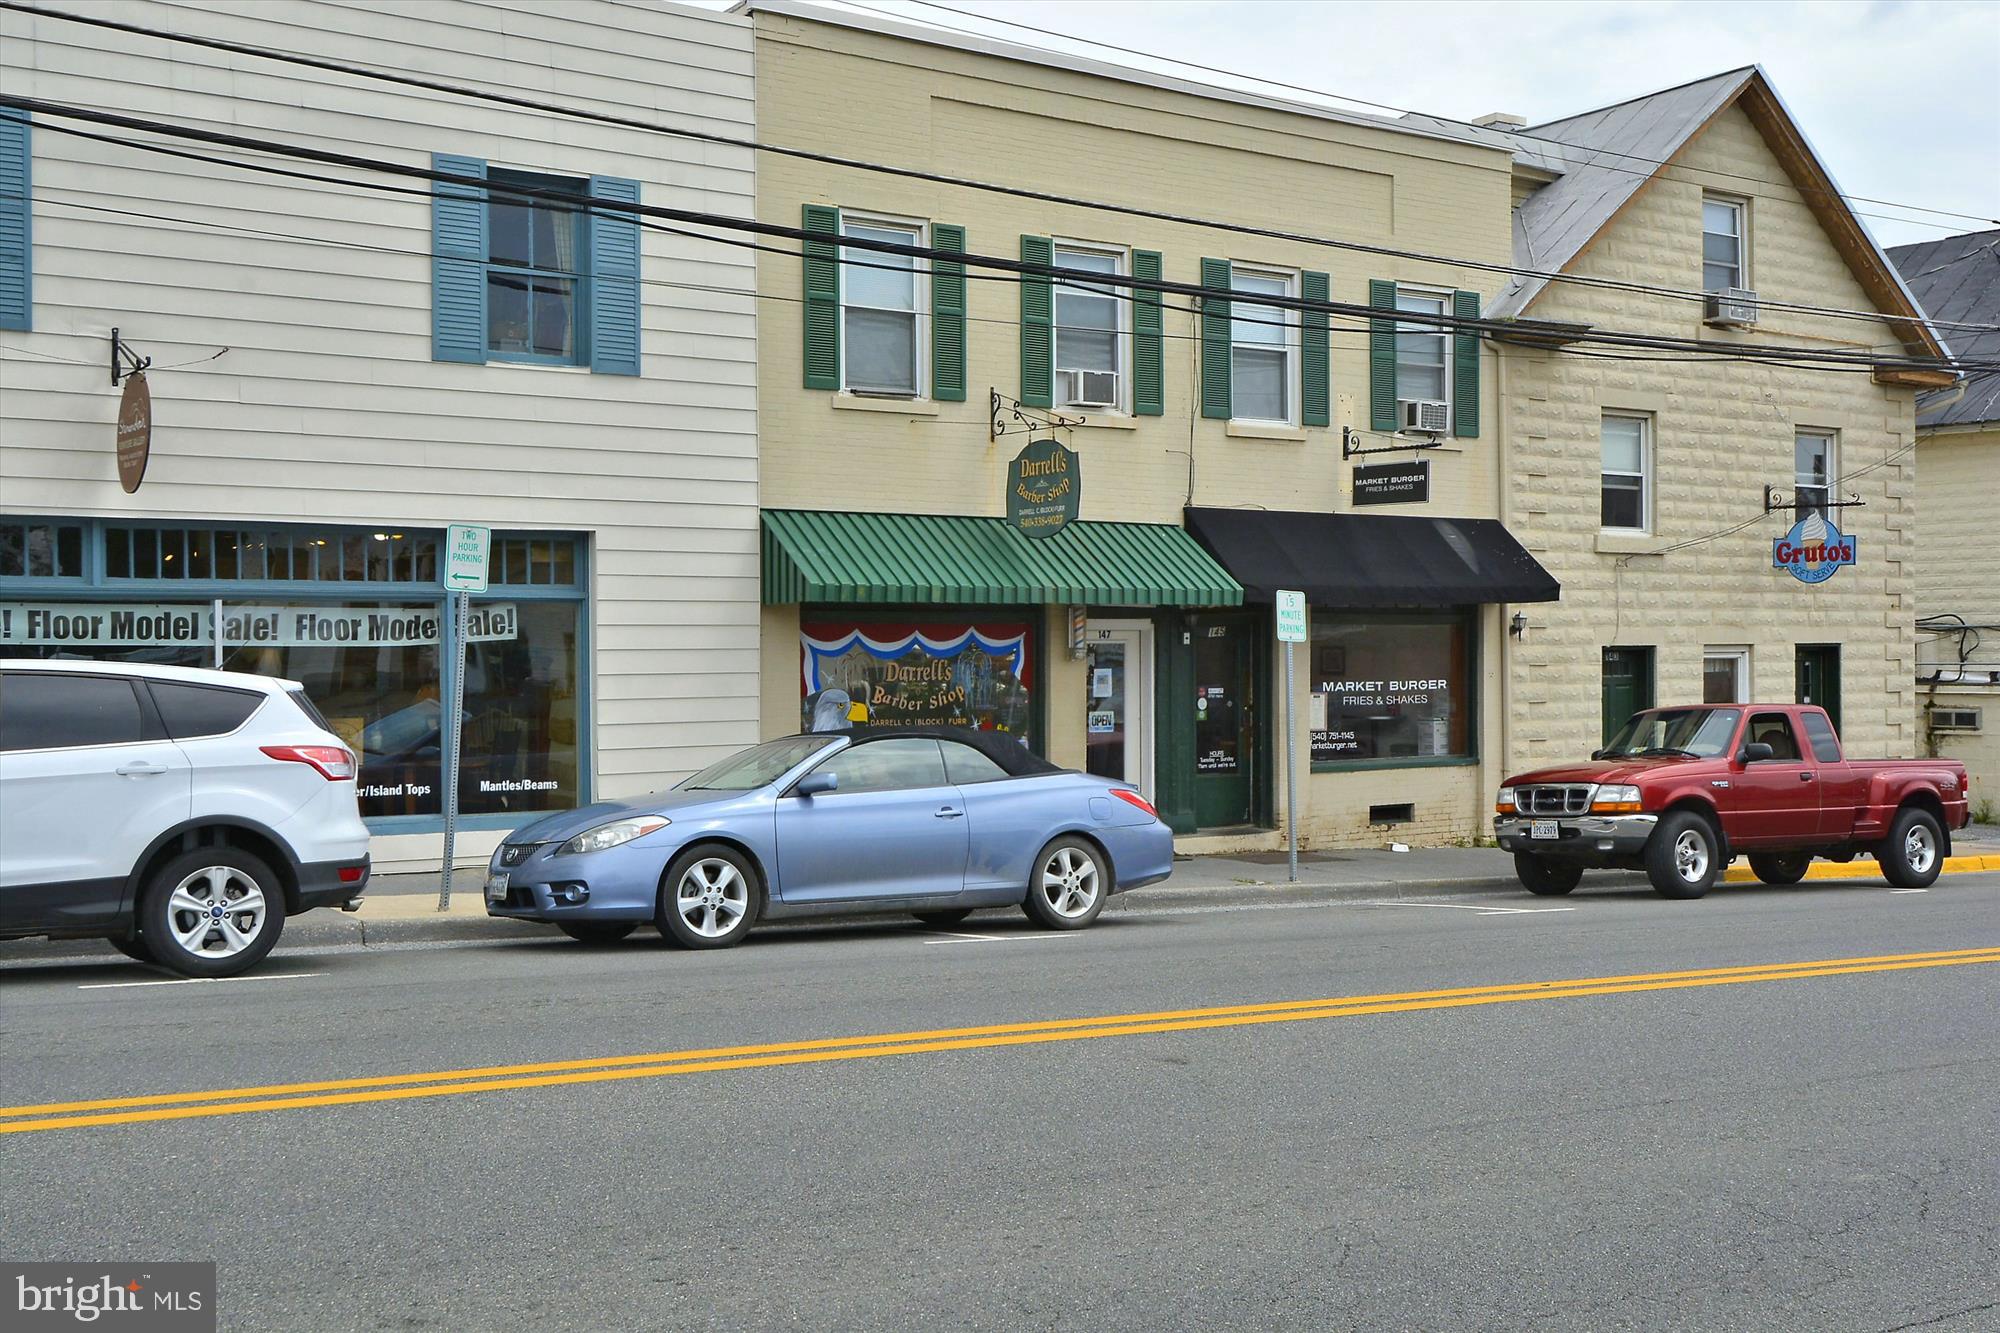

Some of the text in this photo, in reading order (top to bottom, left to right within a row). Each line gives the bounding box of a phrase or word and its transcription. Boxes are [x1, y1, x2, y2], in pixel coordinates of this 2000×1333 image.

[1021, 451, 1067, 477] Darrell's
[1355, 474, 1425, 486] MARKET BURGER
[1016, 478, 1070, 503] Barber Shop
[462, 531, 476, 541] TWO
[458, 542, 478, 552] HOUR
[1776, 540, 1852, 563] Gruto's
[453, 552, 482, 564] PARKING
[1791, 562, 1835, 579] SOFT SERVE
[1287, 597, 1295, 607] 15
[1281, 610, 1302, 620] MINUTE
[27, 610, 103, 640] Floor
[111, 611, 199, 640] Model
[295, 613, 362, 641] Floor
[455, 608, 514, 637] ale!
[1280, 623, 1304, 633] PARKING
[1098, 630, 1111, 639] 147
[885, 659, 953, 682] Darrell's
[1322, 680, 1447, 692] MARKET BURGER
[871, 685, 965, 711] Barber Shop
[1343, 694, 1428, 706] FRIES & SHAKES
[870, 719, 902, 727] DARRELL
[914, 718, 944, 726] (BLOCK)
[1091, 714, 1113, 727] OPEN
[405, 783, 431, 797] Tops
[480, 779, 558, 792] Mantles/Beams
